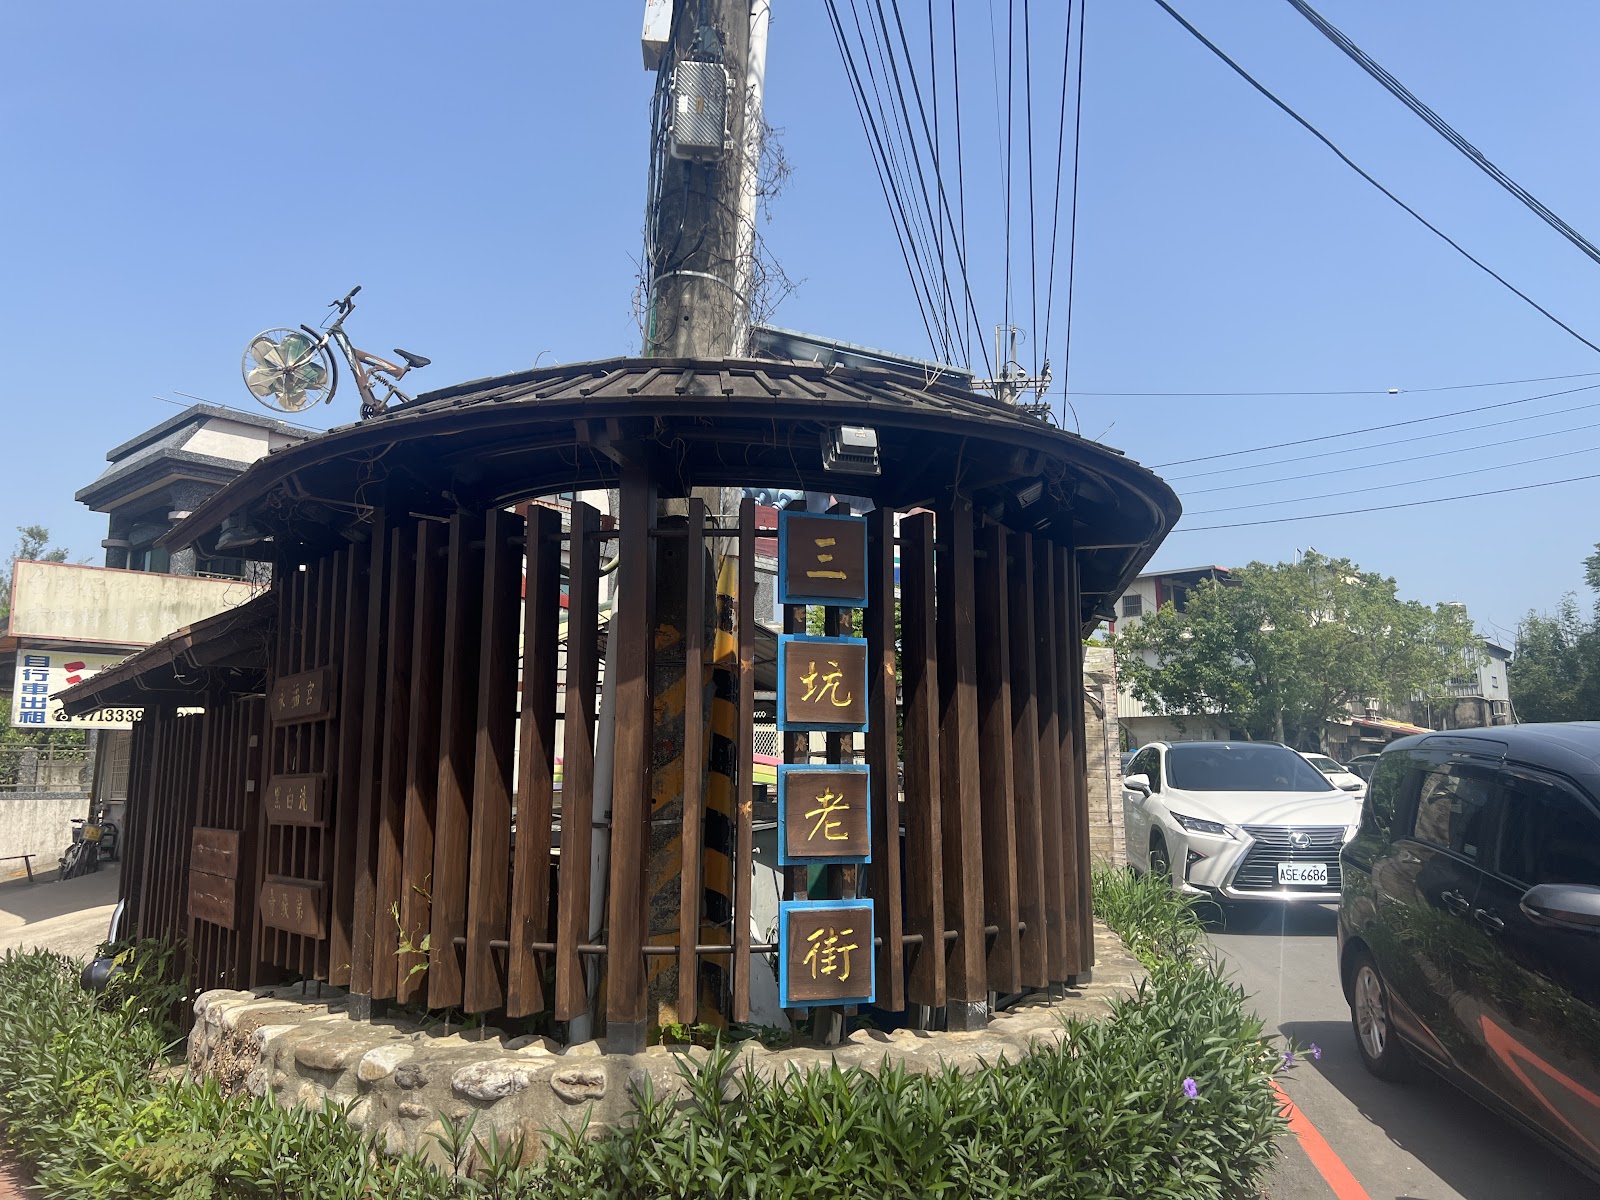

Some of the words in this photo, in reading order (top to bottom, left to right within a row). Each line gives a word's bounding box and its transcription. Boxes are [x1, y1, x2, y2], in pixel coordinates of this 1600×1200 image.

[18, 654, 51, 725] 自行車出租
[799, 537, 859, 982] 三坑老街
